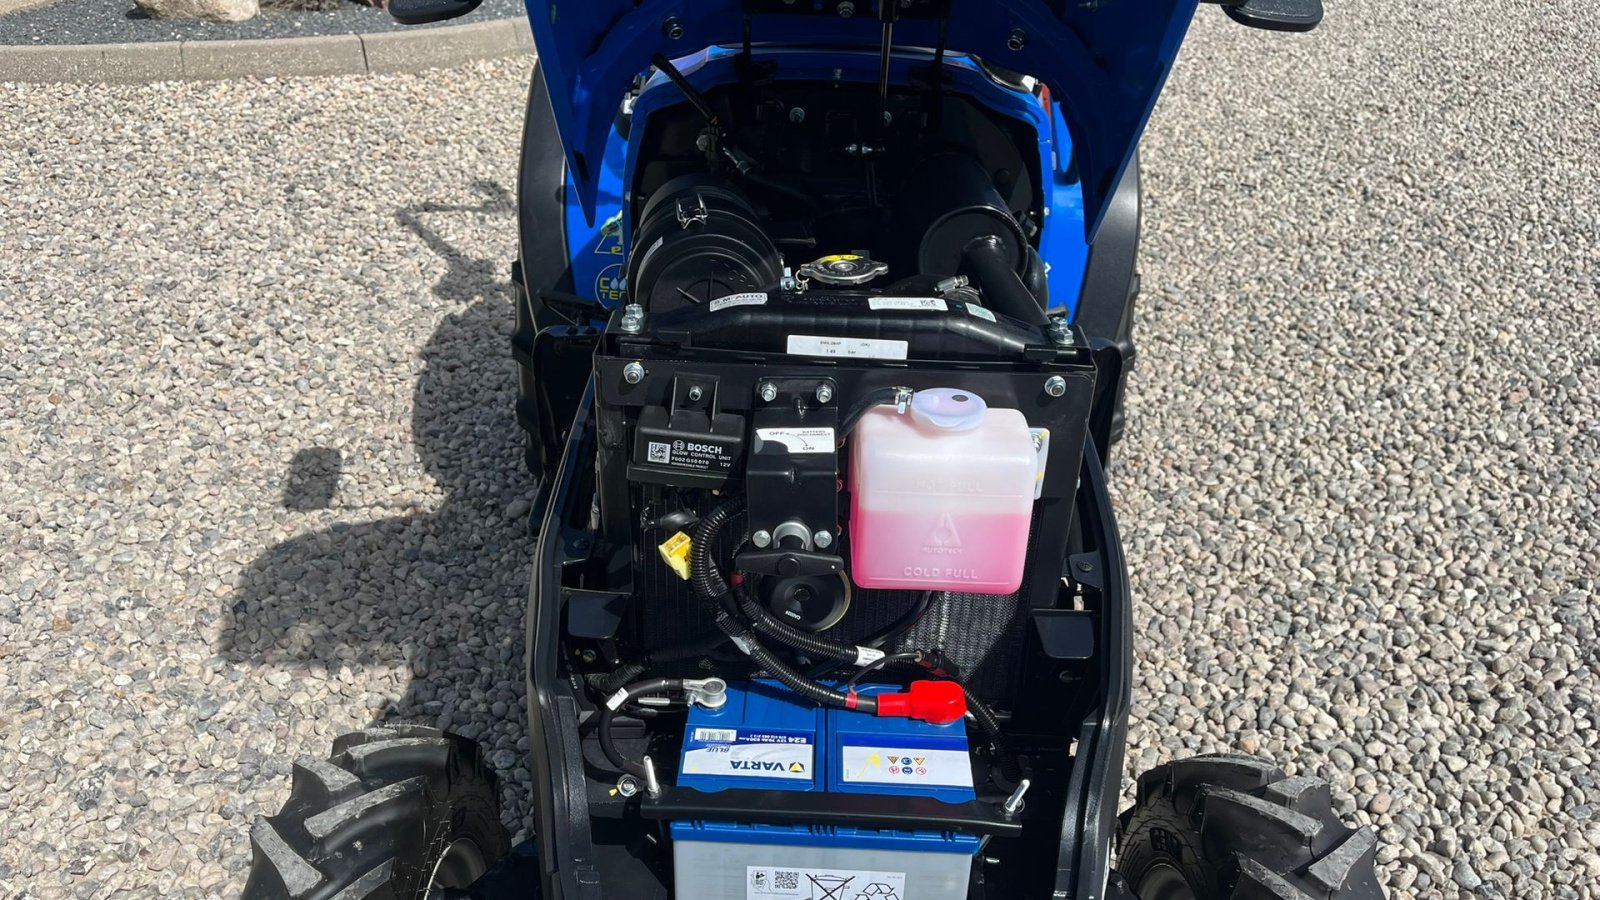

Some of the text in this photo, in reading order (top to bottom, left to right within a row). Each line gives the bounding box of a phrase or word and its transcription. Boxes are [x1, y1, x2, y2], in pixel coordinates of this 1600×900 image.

[687, 442, 722, 454] BOSCH
[690, 452, 716, 460] CONTROL
[950, 480, 984, 493] FULL
[903, 566, 978, 579] COLD FULL
[788, 736, 807, 744] E24
[730, 760, 785, 772] VARTA
